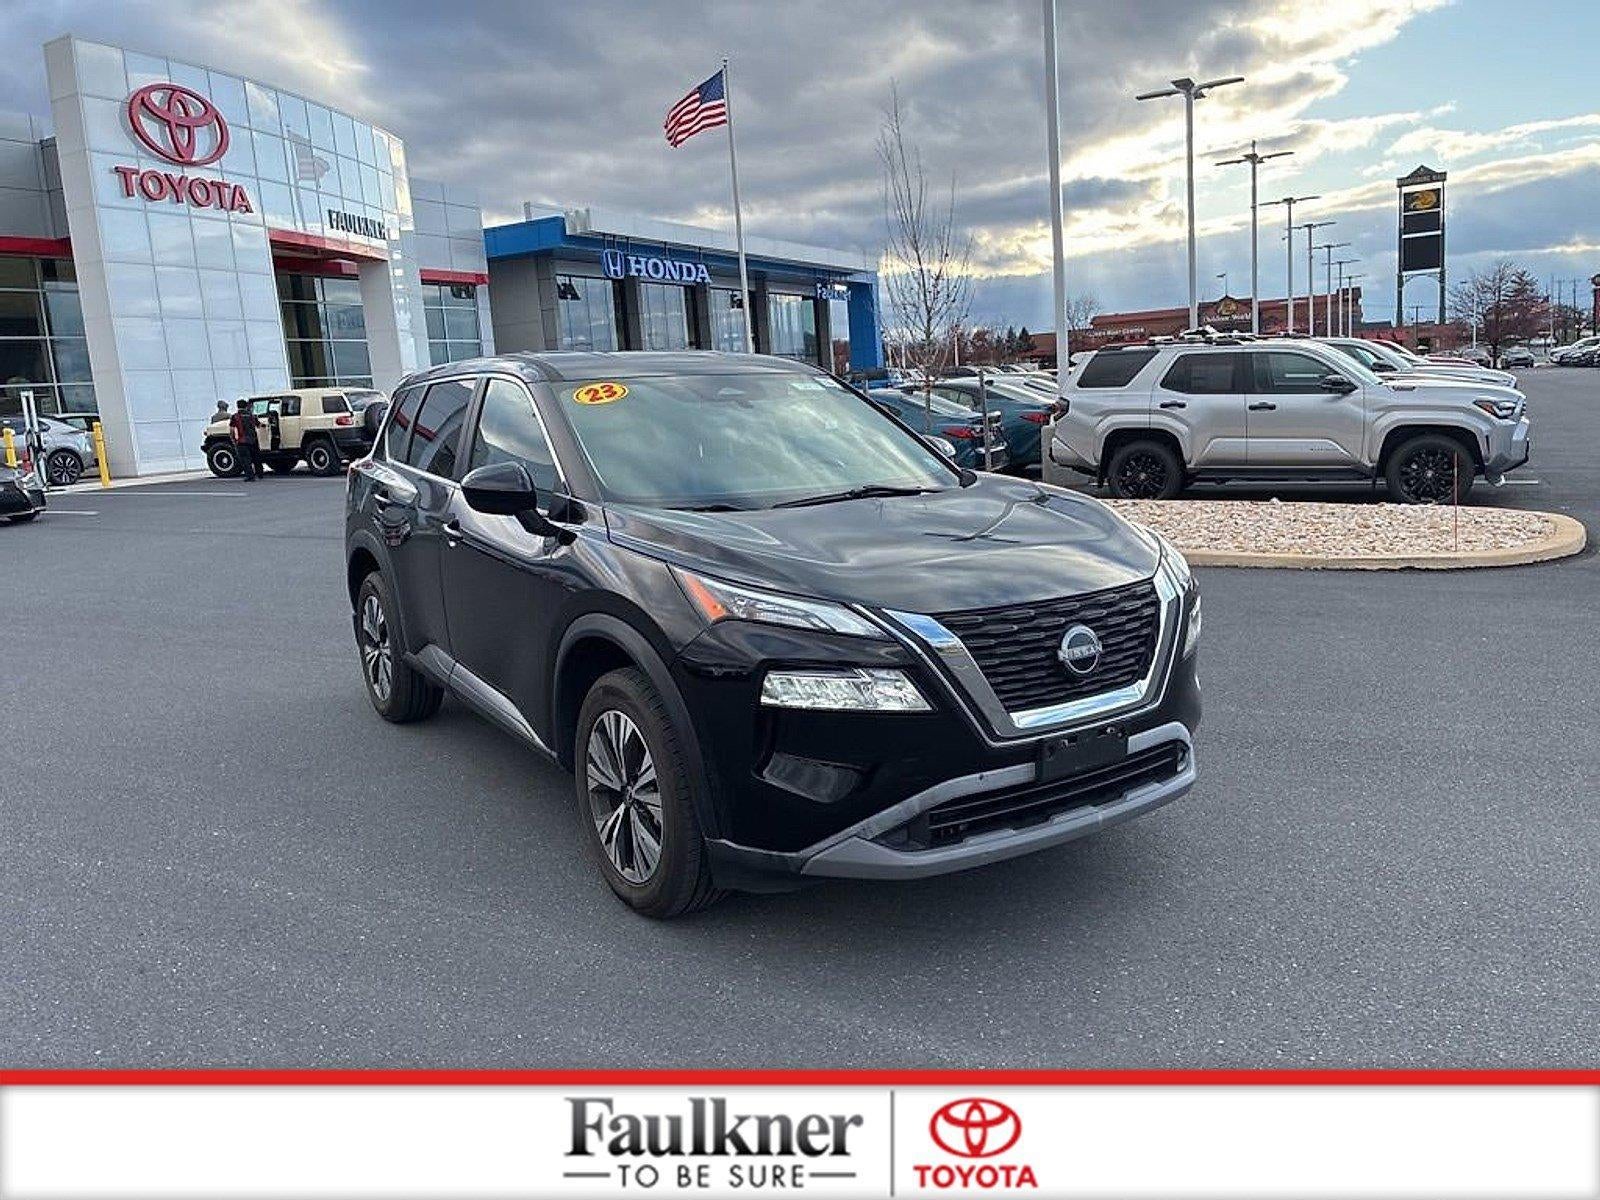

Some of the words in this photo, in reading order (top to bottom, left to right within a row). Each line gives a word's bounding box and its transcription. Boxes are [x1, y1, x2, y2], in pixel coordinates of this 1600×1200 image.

[114, 166, 253, 214] TOYOTA
[628, 256, 711, 283] HONDA
[584, 383, 619, 402] 23
